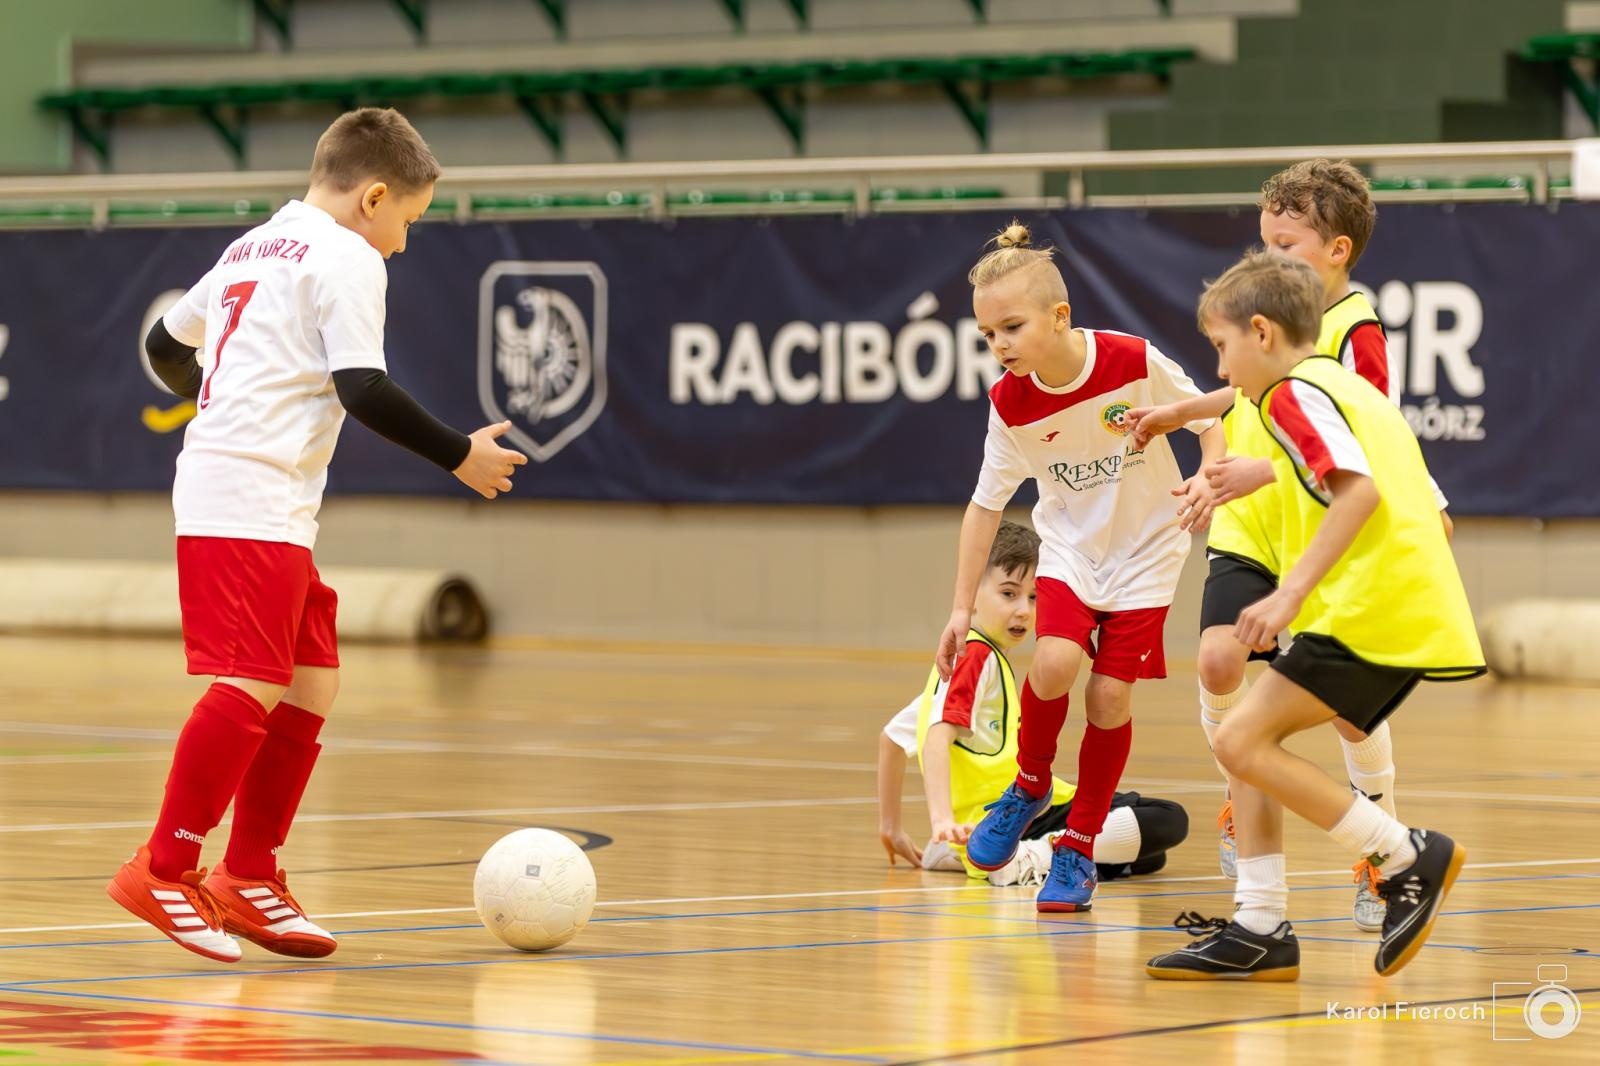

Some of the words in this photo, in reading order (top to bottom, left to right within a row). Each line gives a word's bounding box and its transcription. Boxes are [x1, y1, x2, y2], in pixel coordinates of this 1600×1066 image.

[200, 280, 259, 410] 7
[669, 290, 1001, 405] RACIBÓR
[1348, 280, 1486, 398] iR
[1401, 396, 1487, 441] BÓRZ
